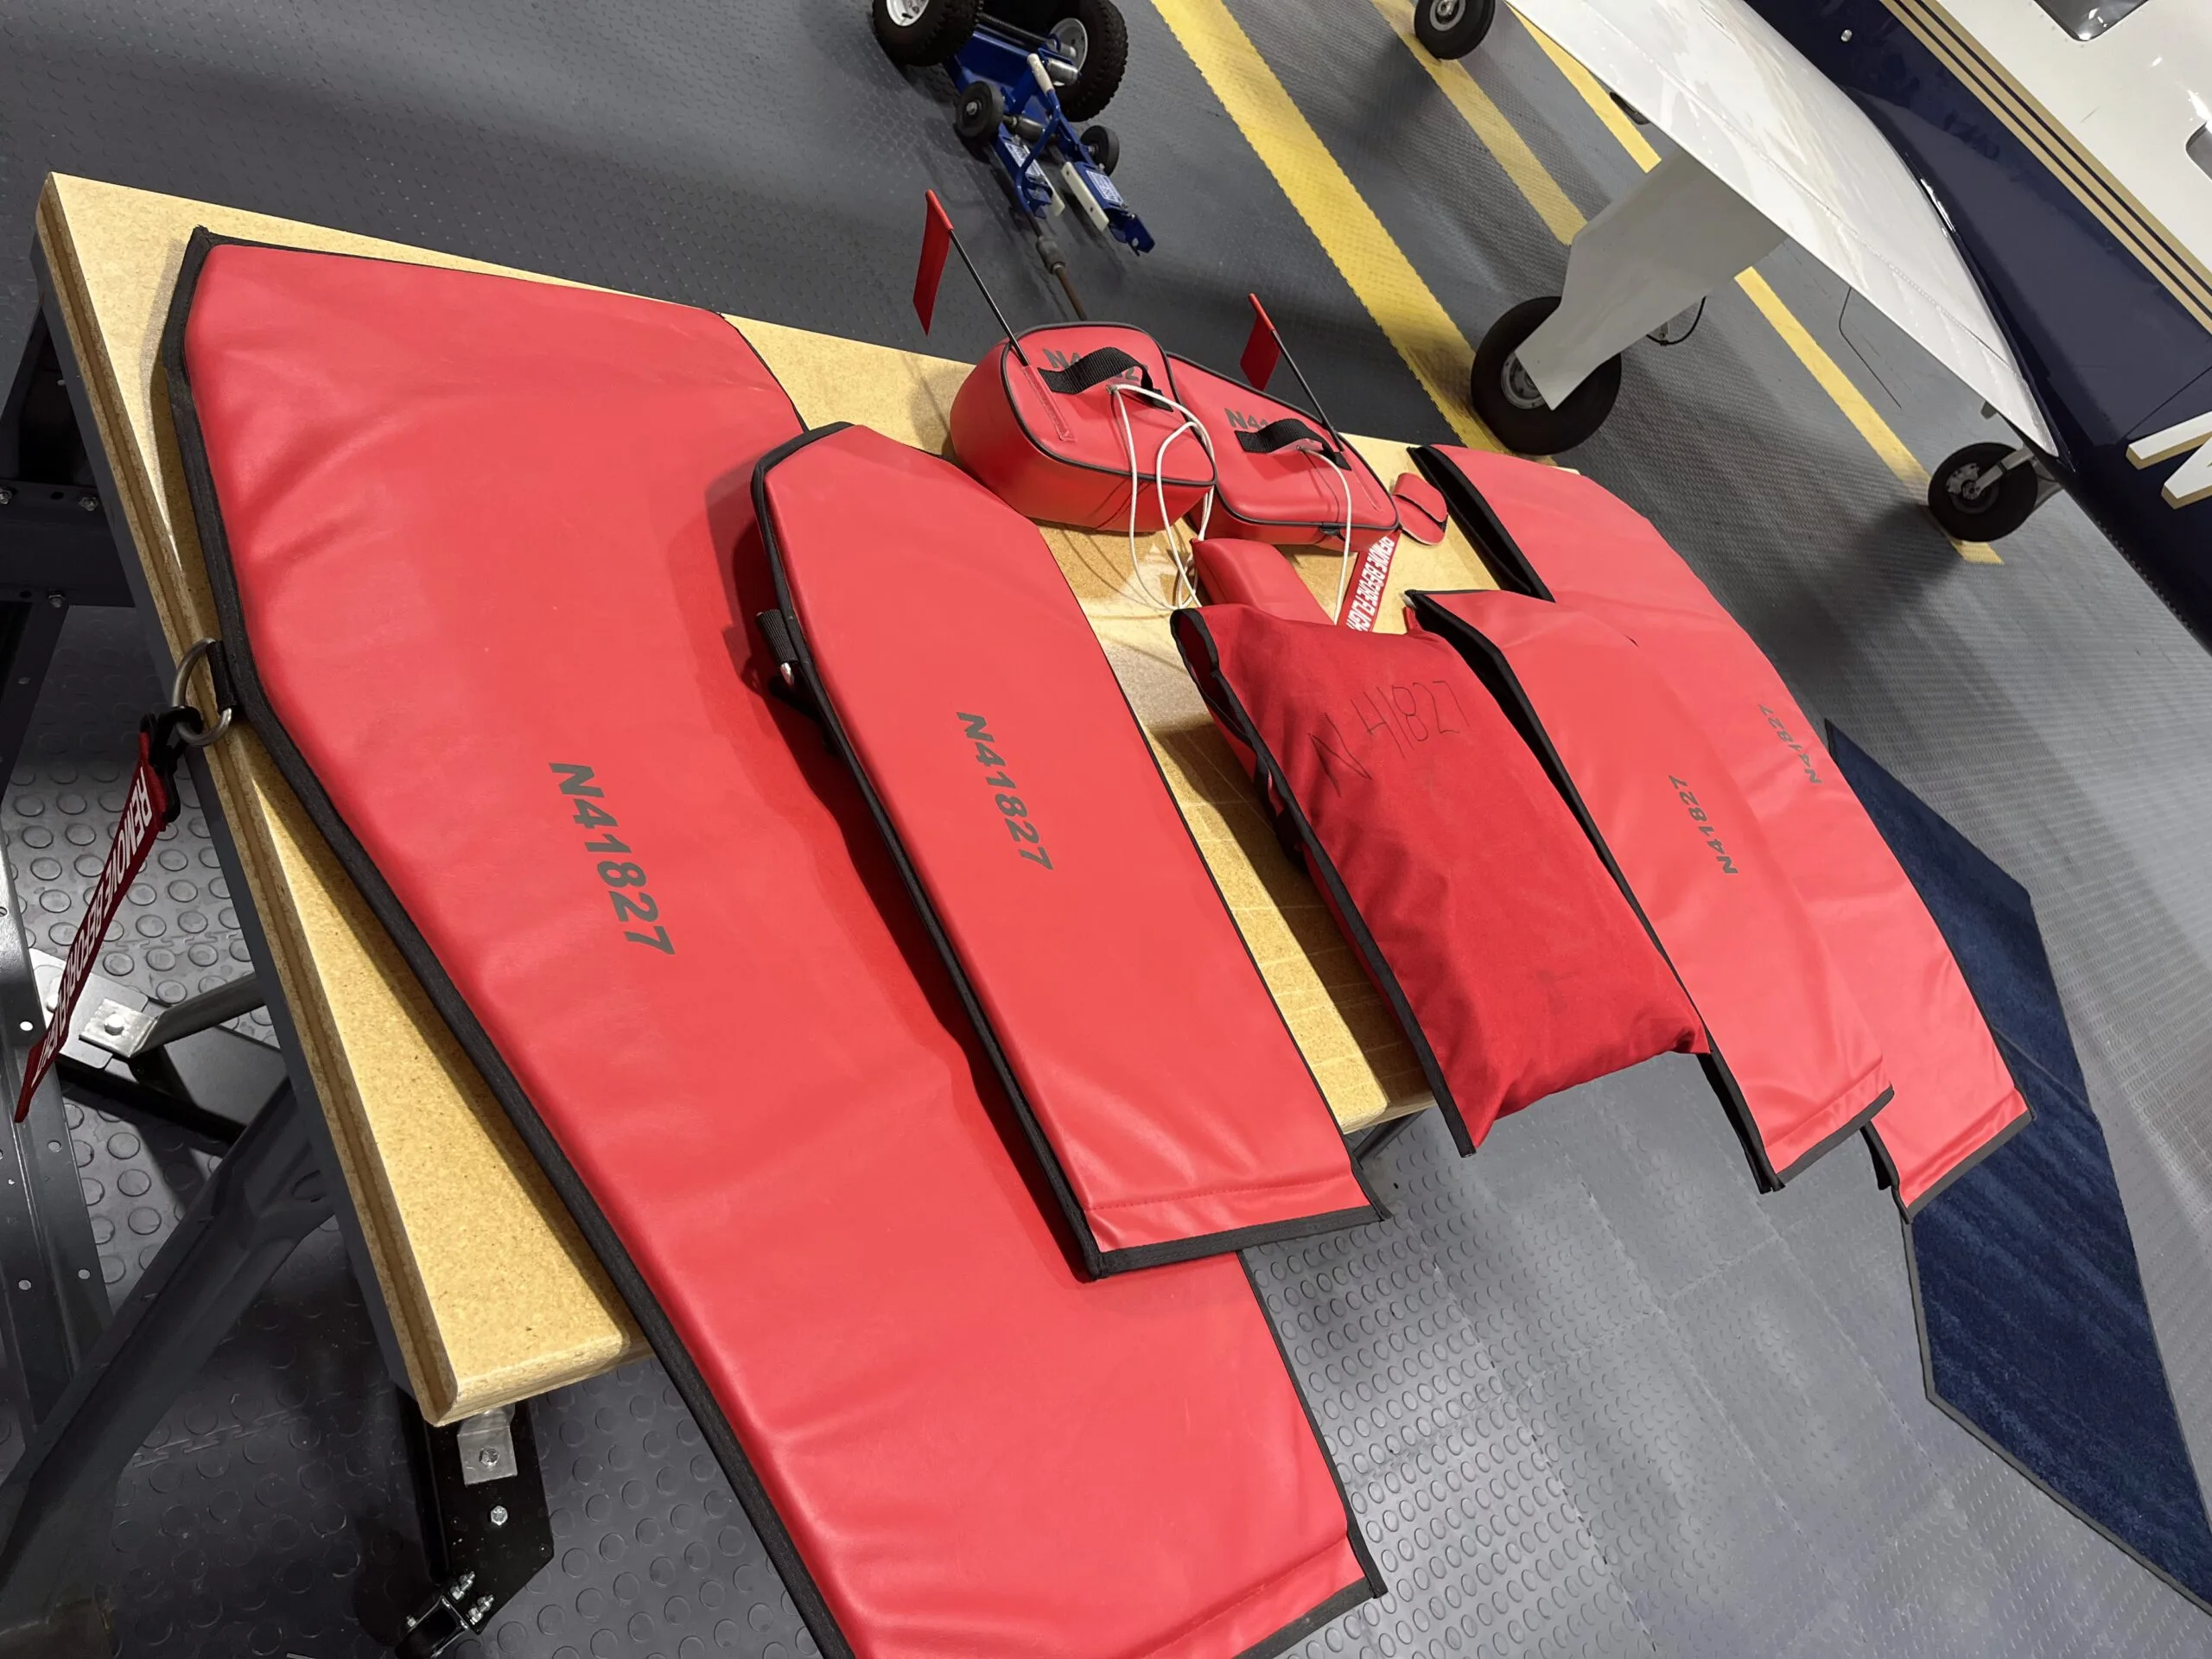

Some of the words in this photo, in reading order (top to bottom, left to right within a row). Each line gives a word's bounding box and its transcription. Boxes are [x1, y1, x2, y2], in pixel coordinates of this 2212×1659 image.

[1346, 595, 1376, 632] FLIGH
[957, 711, 1053, 870] N41827
[1308, 681, 1471, 798] N41827
[1758, 704, 1822, 784] N41827
[103, 766, 153, 918] REMOVE
[548, 762, 676, 956] N41827
[1669, 775, 1738, 874] N41827
[67, 881, 104, 1012] BEFORE
